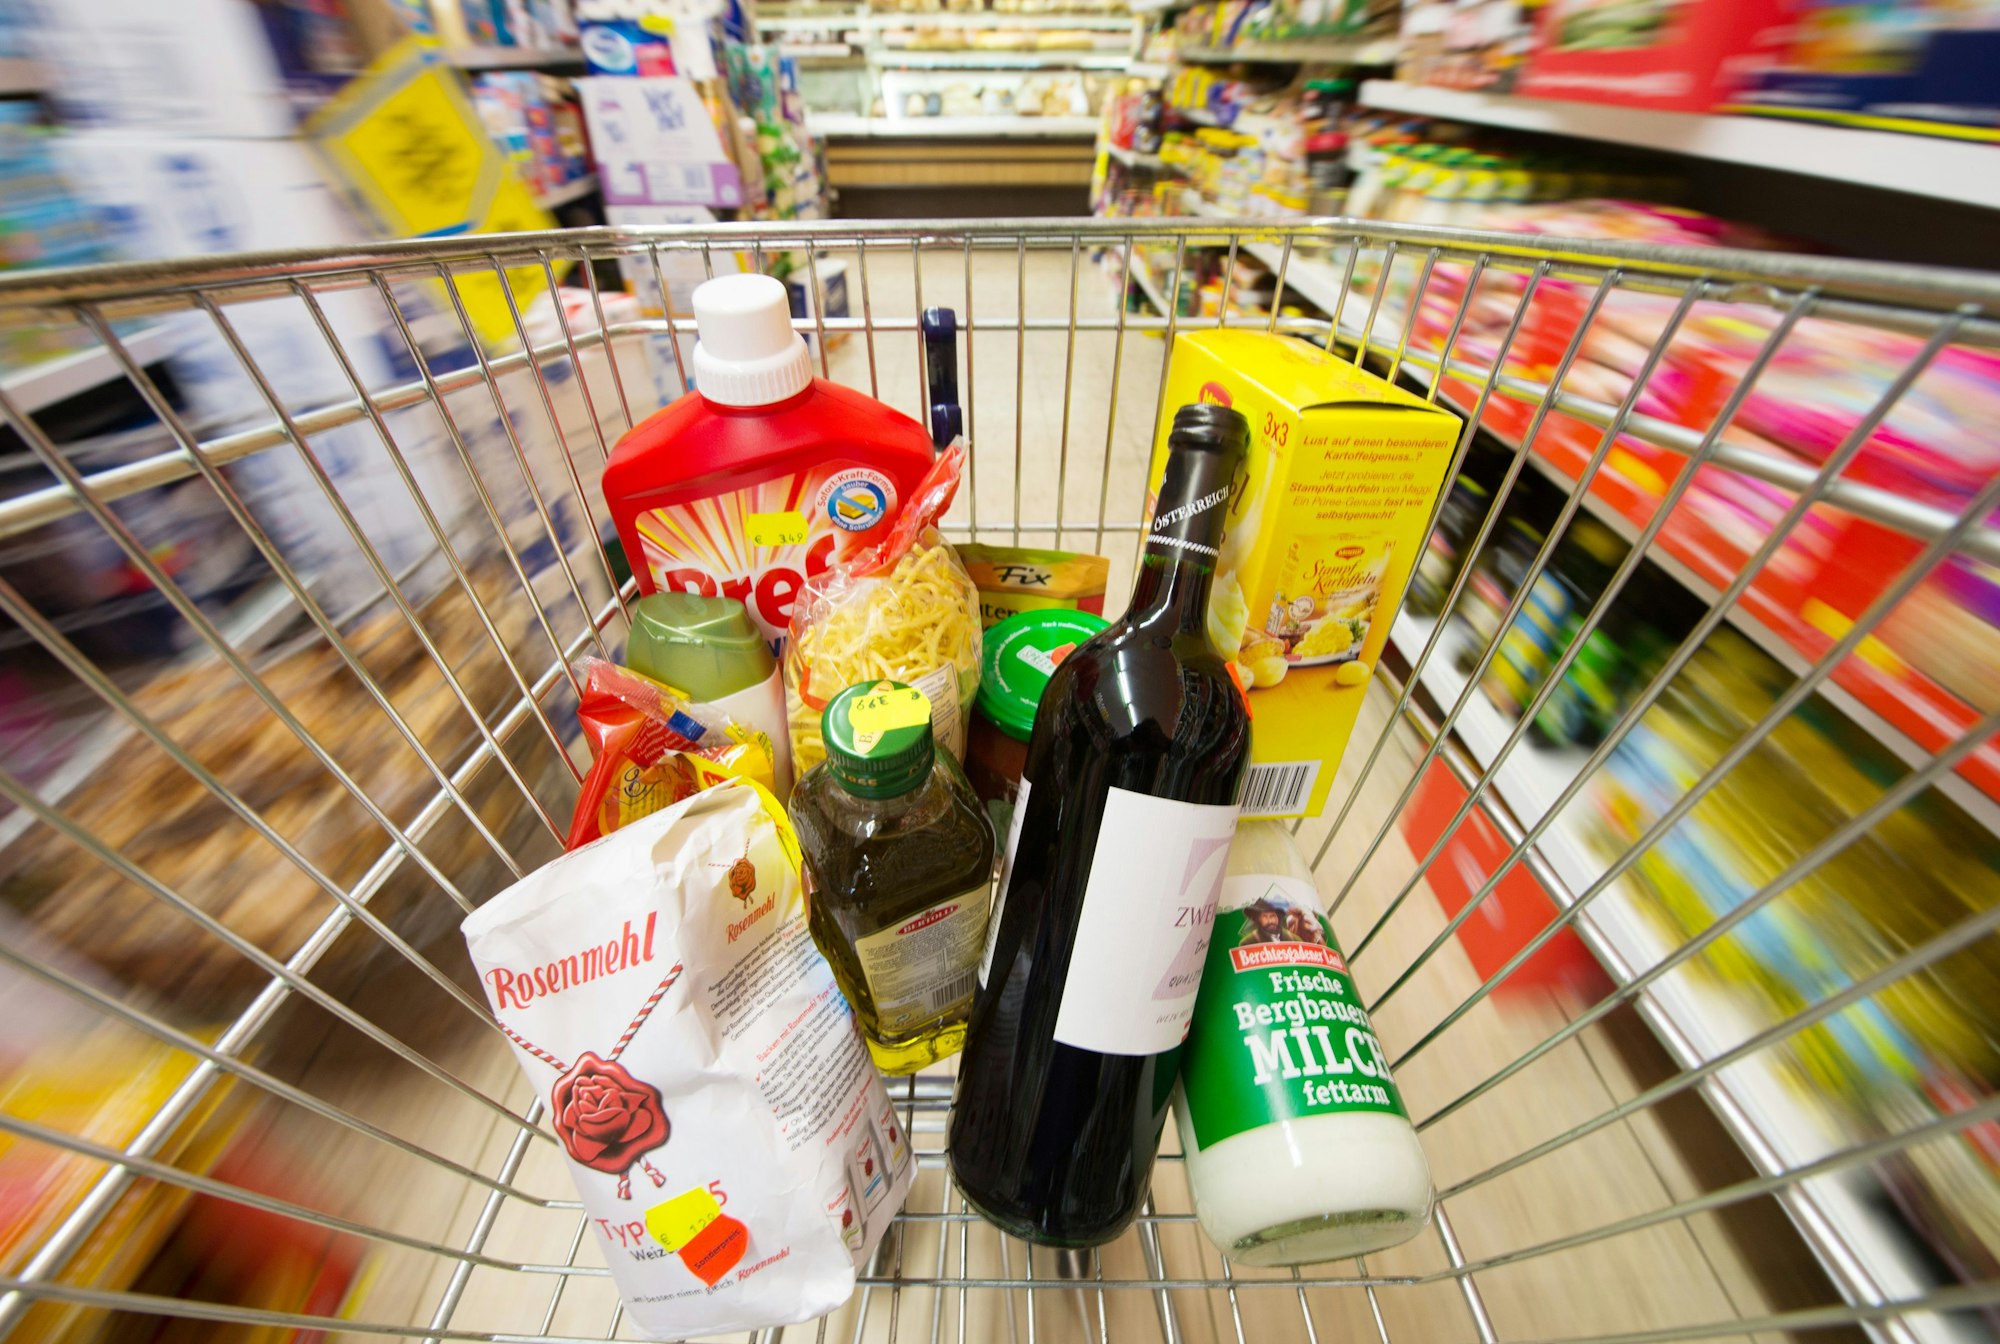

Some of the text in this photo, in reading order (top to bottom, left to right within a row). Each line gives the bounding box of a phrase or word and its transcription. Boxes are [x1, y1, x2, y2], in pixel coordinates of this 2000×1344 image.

[1263, 411, 1289, 447] 3x3
[1303, 436, 1448, 448] Lust auf einen besonderen
[841, 480, 869, 491] Sauber
[1320, 469, 1345, 480] Jetzt
[1399, 471, 1415, 480] die
[818, 470, 895, 507] Sofort-Kraft-Formel
[1289, 482, 1380, 494] Stampfkartoffeln
[1154, 484, 1230, 533] ÖSTERREICH
[1293, 497, 1310, 506] Ein
[1384, 497, 1403, 507] fast
[1406, 498, 1424, 507] wie
[1316, 510, 1396, 521] selbstgemacht!
[754, 536, 763, 545] €
[992, 566, 1053, 586] Fix
[1303, 558, 1361, 580] Stampf
[1312, 571, 1377, 595] Kartoffeln
[727, 892, 776, 944] Rosenmehl
[903, 906, 955, 933] BERTOLLI
[485, 911, 658, 1010] Rosenmehl
[1239, 945, 1325, 967] Berchtesgadener
[1268, 969, 1345, 996] Frische
[1244, 1025, 1396, 1087] MILCH
[1303, 1079, 1391, 1107] fettarm
[595, 1217, 646, 1248] Typ
[736, 1246, 790, 1282] Rosenmehl
